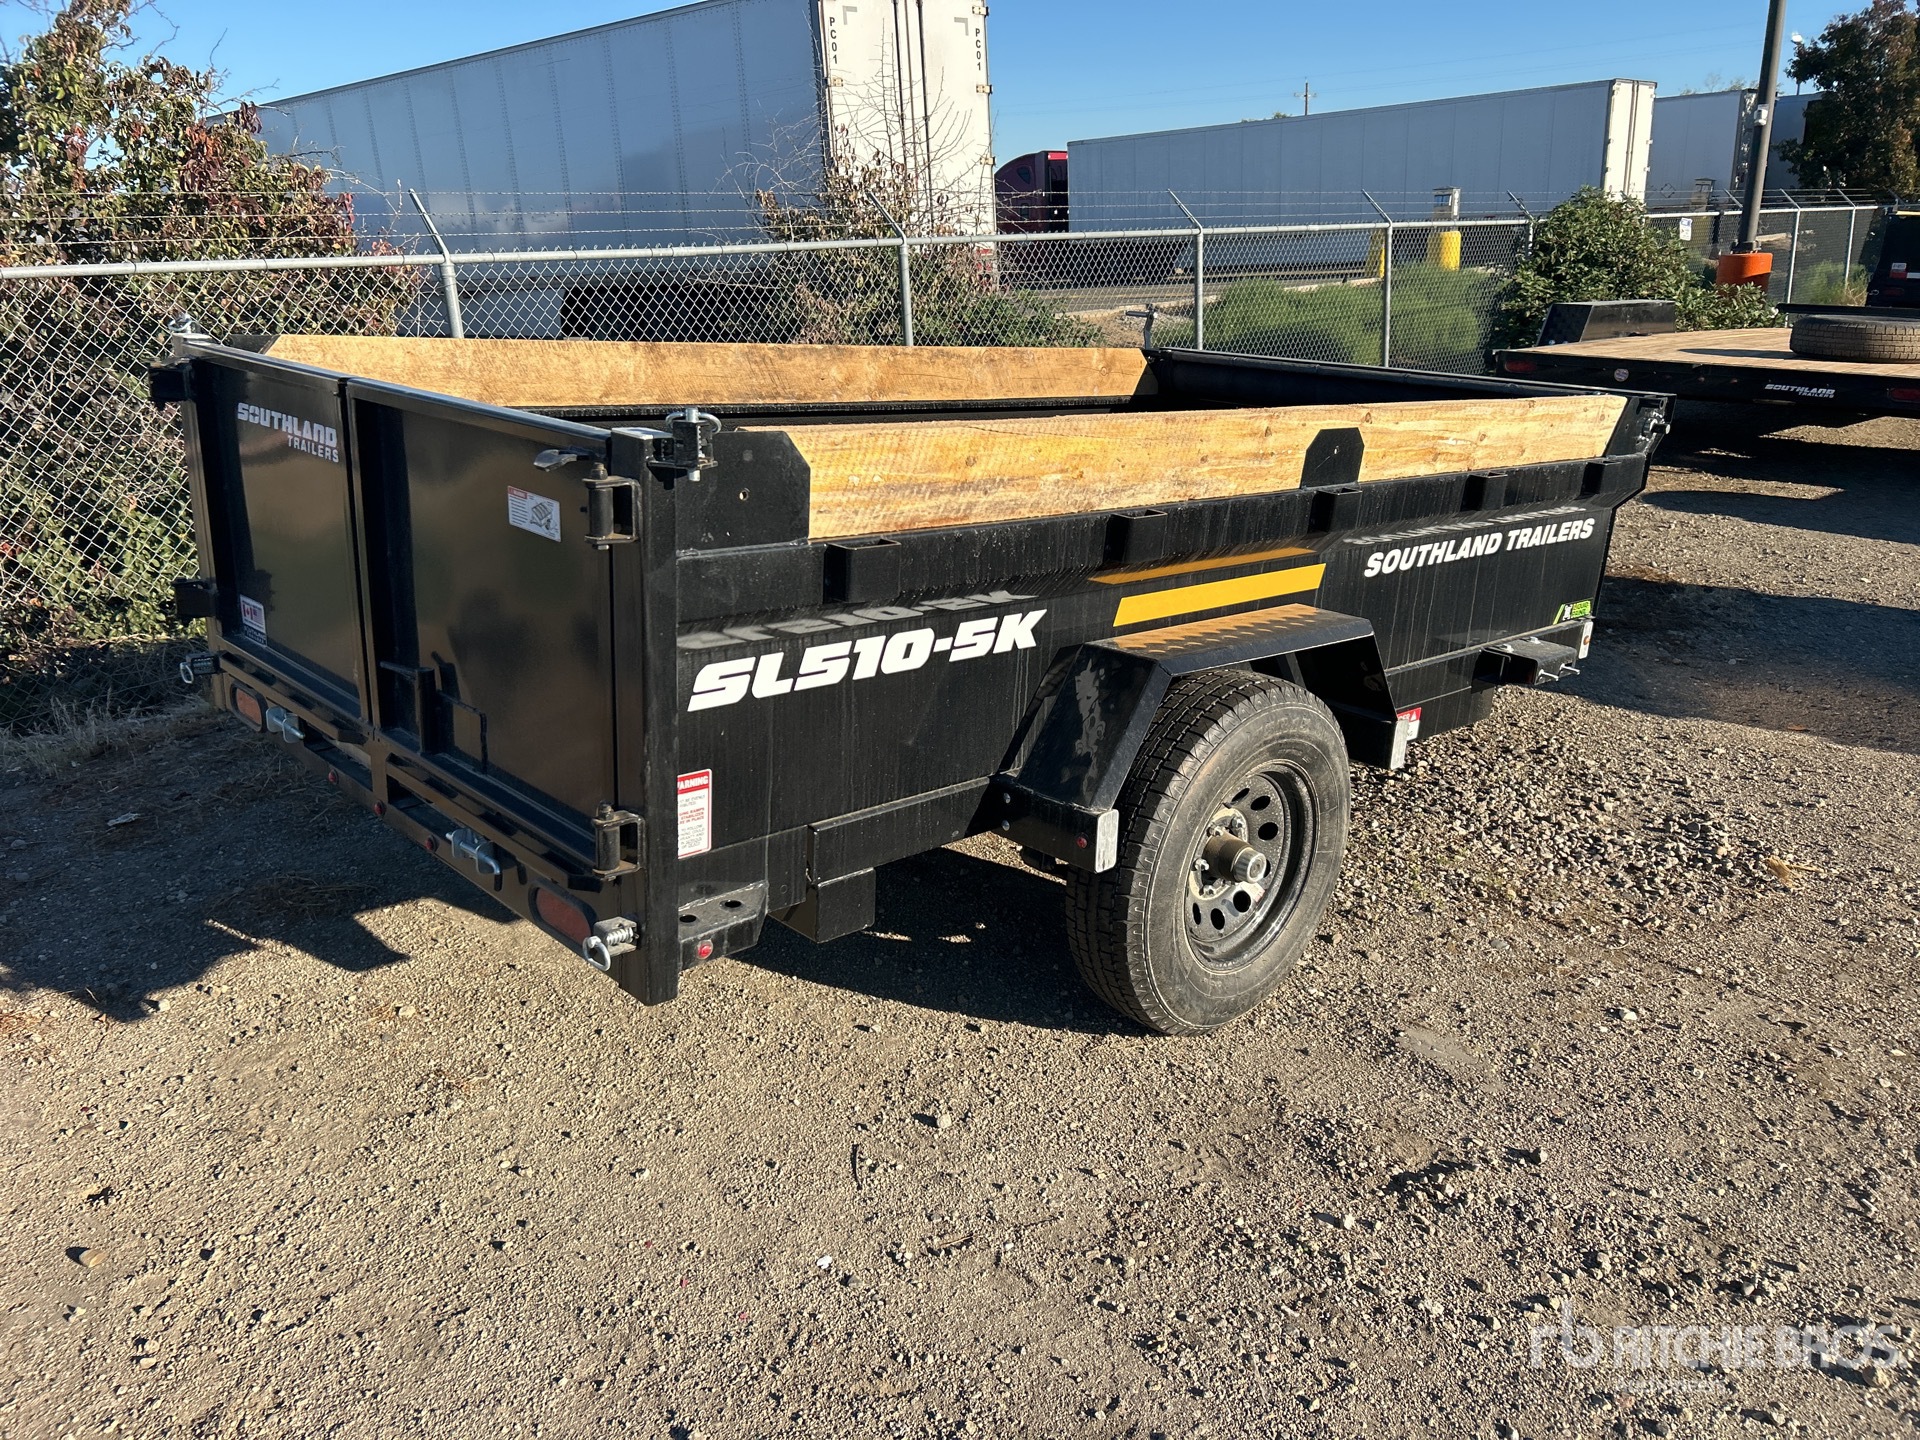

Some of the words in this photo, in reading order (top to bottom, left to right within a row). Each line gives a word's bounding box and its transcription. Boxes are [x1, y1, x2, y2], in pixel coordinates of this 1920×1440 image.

[829, 17, 838, 64] PC01
[1764, 383, 1836, 395] SOUTHLAND
[237, 402, 338, 448] SOUTHLAND
[287, 434, 339, 463] TRAILERS
[1364, 532, 1503, 577] SOUTHLAND
[1506, 518, 1595, 551] TRAILERS
[686, 608, 1048, 712] SL510-5K
